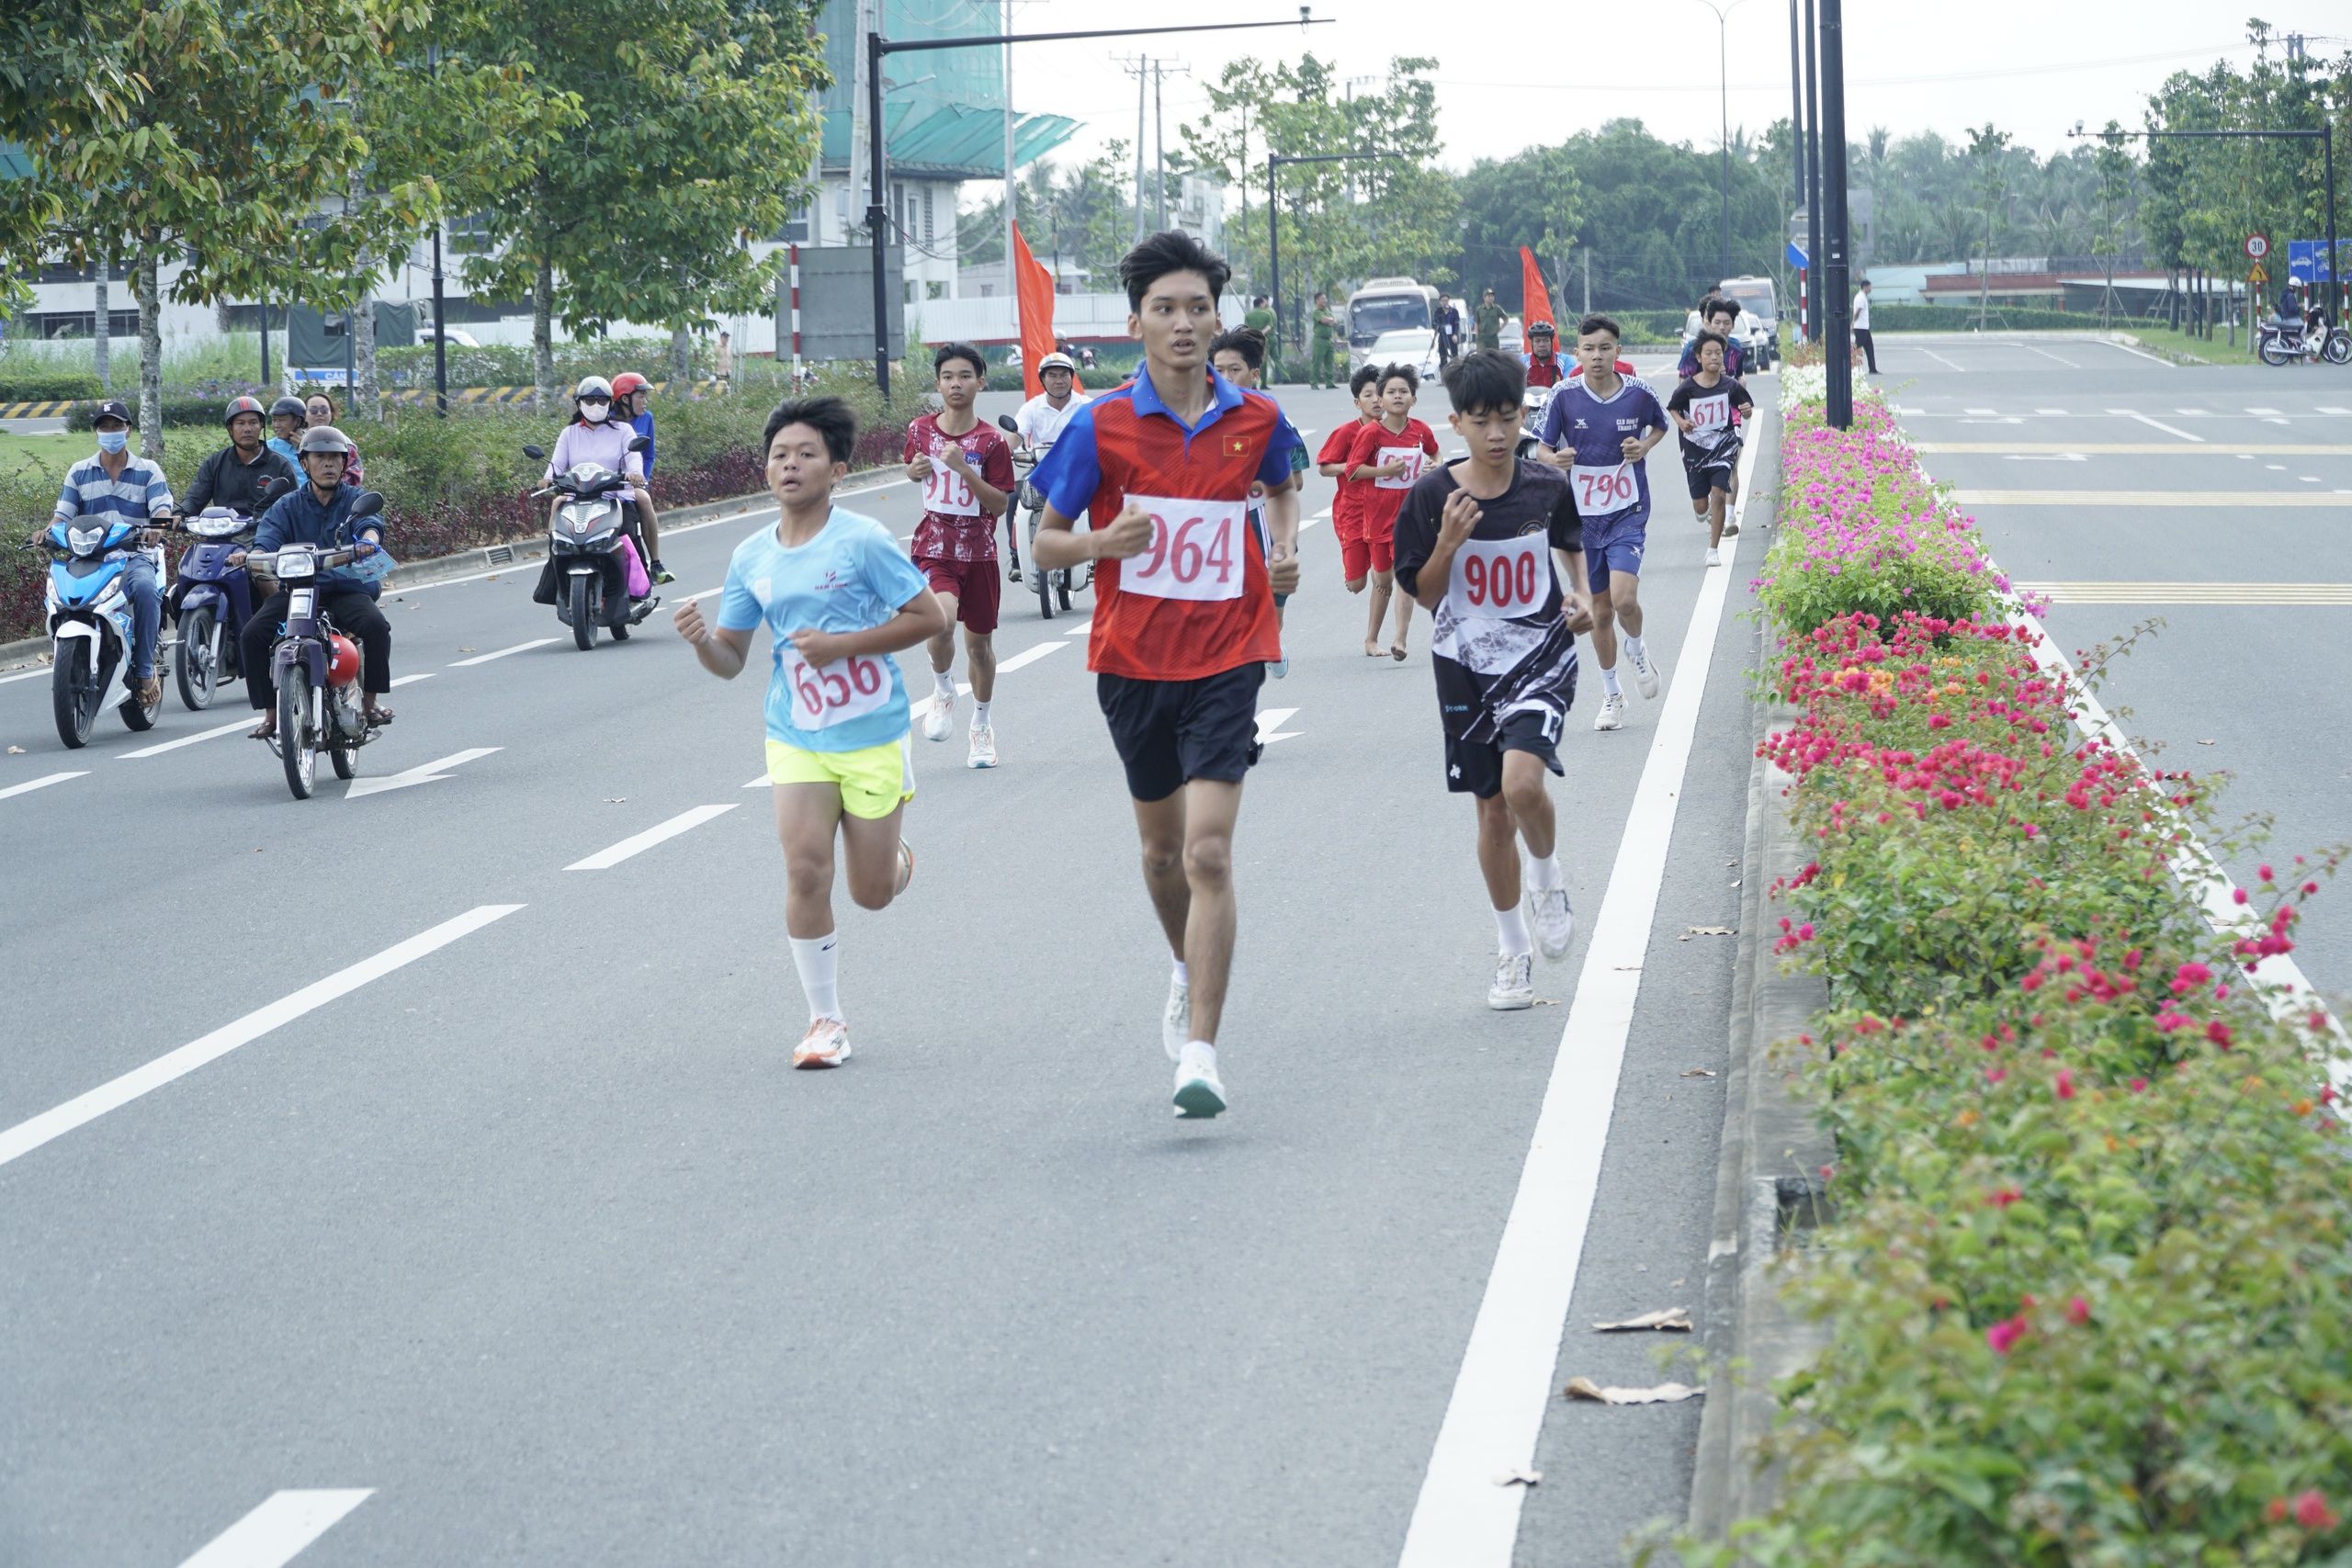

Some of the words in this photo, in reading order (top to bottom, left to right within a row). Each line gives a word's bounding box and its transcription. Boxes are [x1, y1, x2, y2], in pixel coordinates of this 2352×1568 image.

[2252, 241, 2263, 253] 30
[1693, 400, 1726, 426] 671
[925, 468, 974, 508] 915
[1578, 463, 1632, 506] 796
[1136, 513, 1233, 584] 964
[1464, 551, 1535, 608] 900
[794, 654, 881, 716] 656
